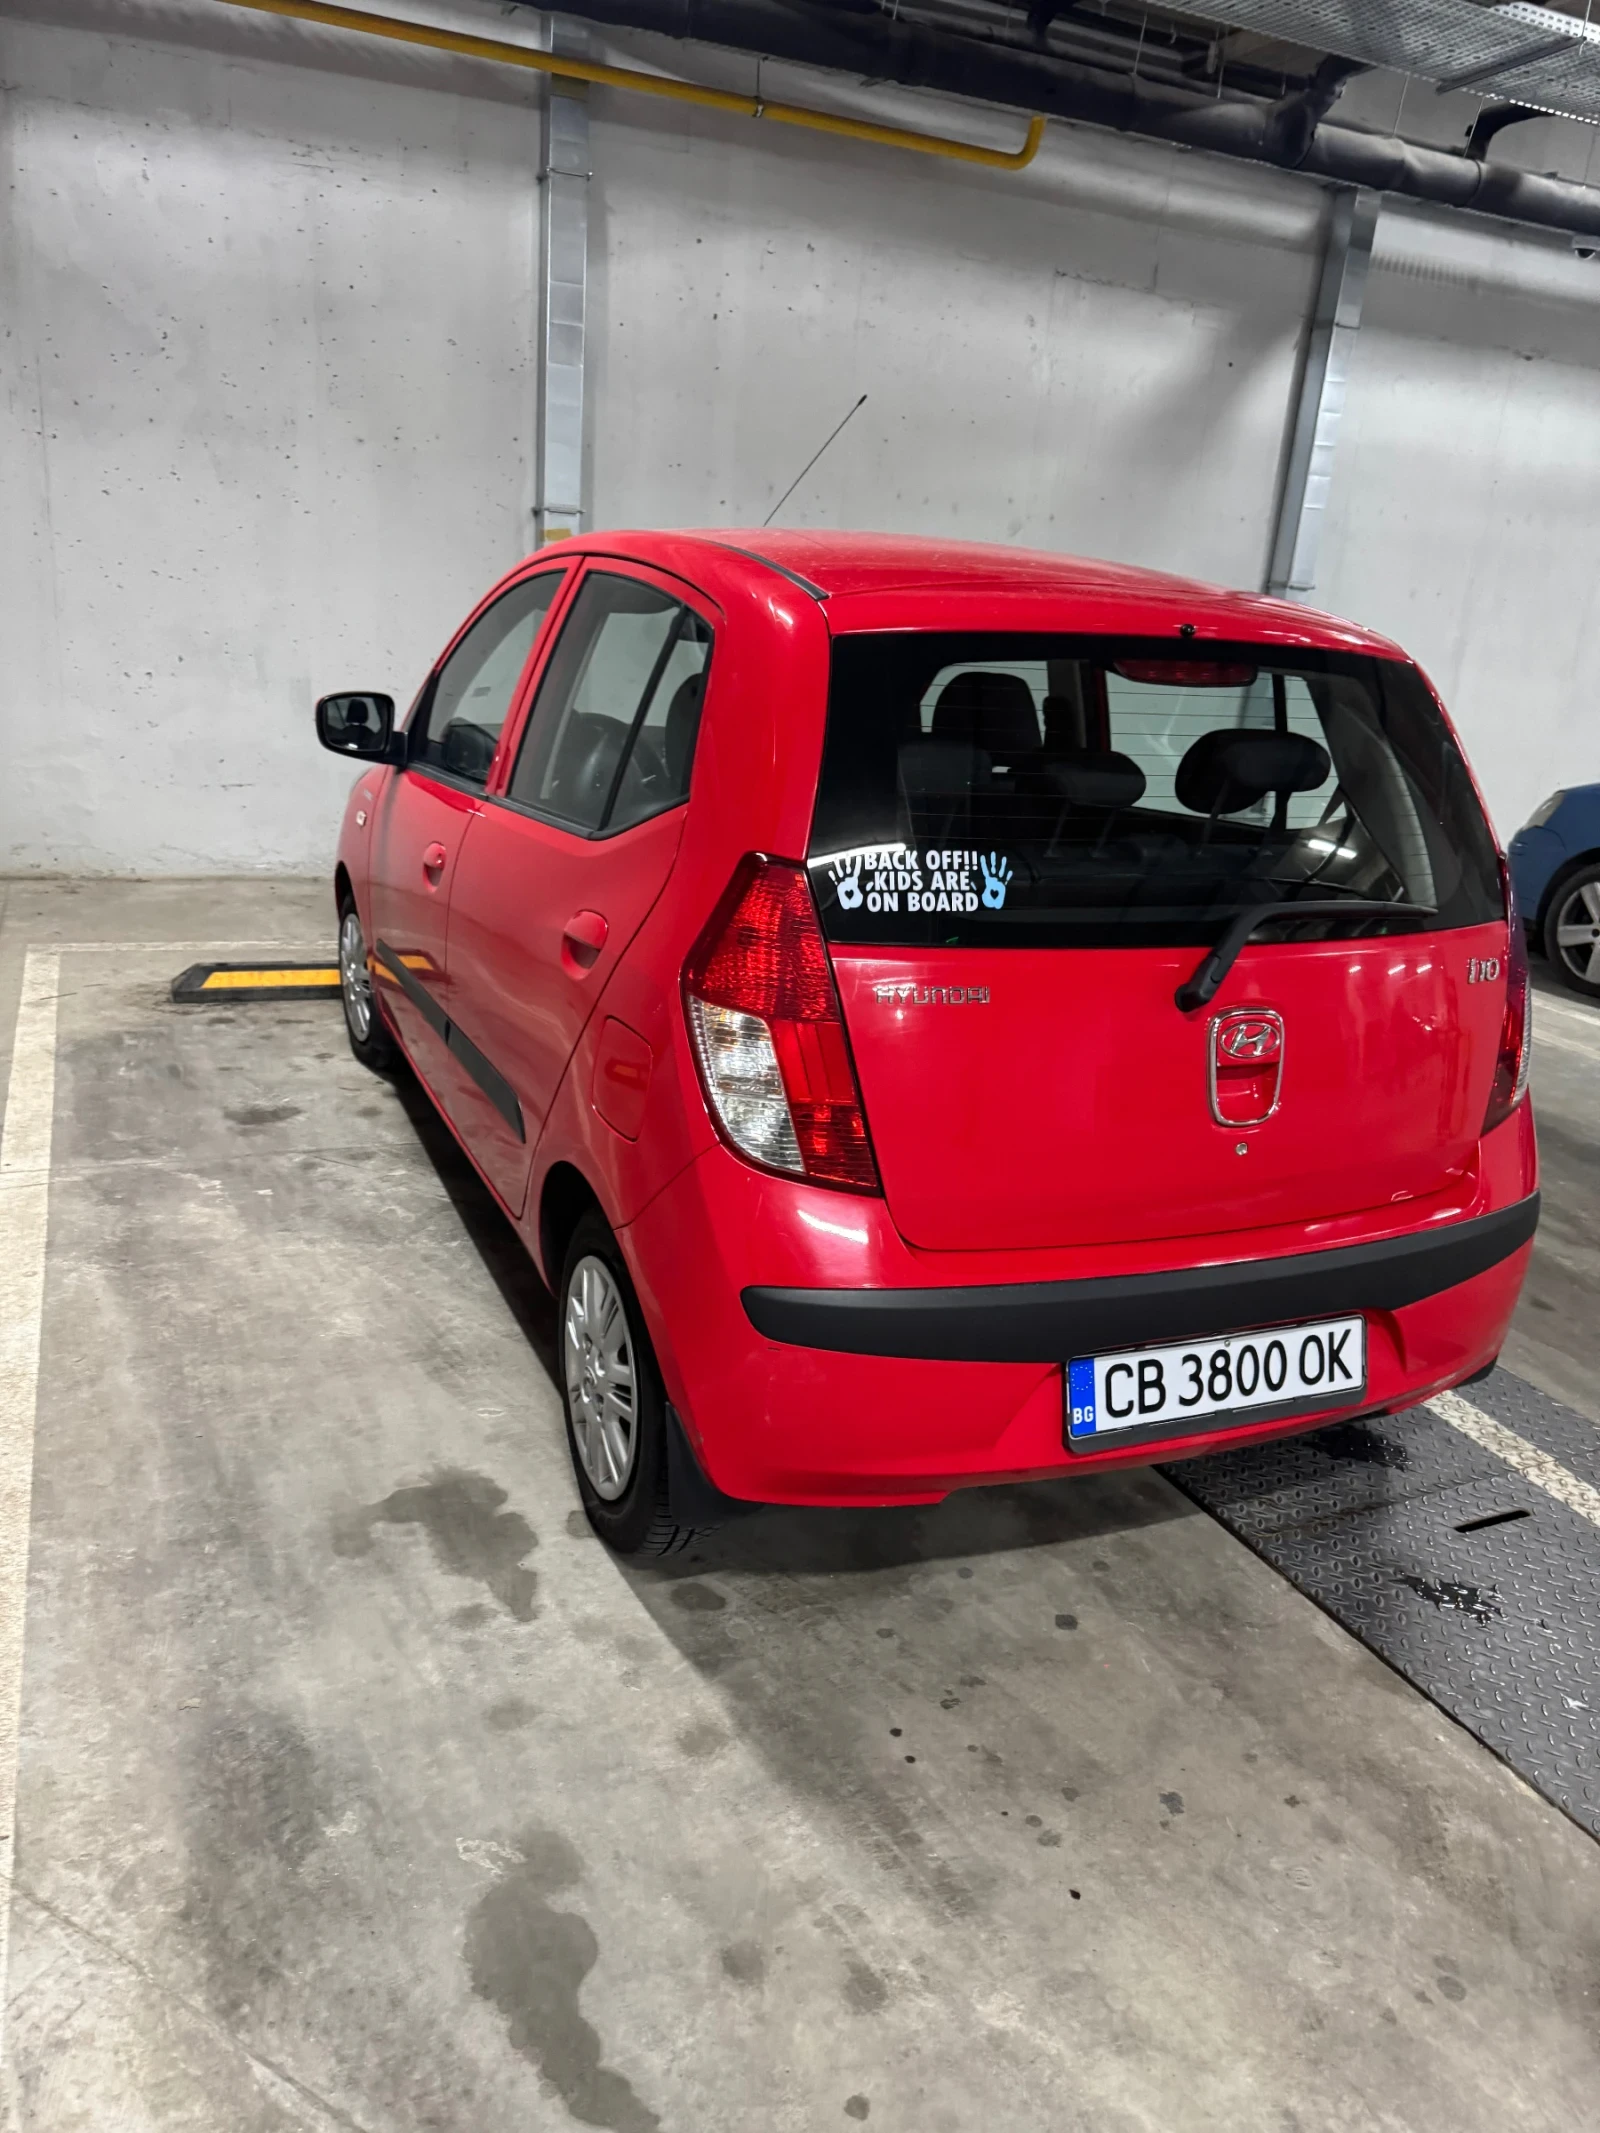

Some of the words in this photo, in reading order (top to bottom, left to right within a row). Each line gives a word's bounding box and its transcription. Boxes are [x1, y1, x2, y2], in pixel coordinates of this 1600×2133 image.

[864, 850, 919, 870] BACK
[926, 850, 978, 870] OFF!!
[874, 871, 923, 891] KIDS
[930, 871, 970, 891] ARE
[867, 892, 899, 912] ON
[907, 892, 978, 912] BOARD
[876, 984, 990, 1004] HYUNDAI
[1105, 1358, 1166, 1418] CB
[1178, 1340, 1288, 1406] 3800
[1299, 1328, 1353, 1385] OK
[1072, 1406, 1094, 1424] BG
